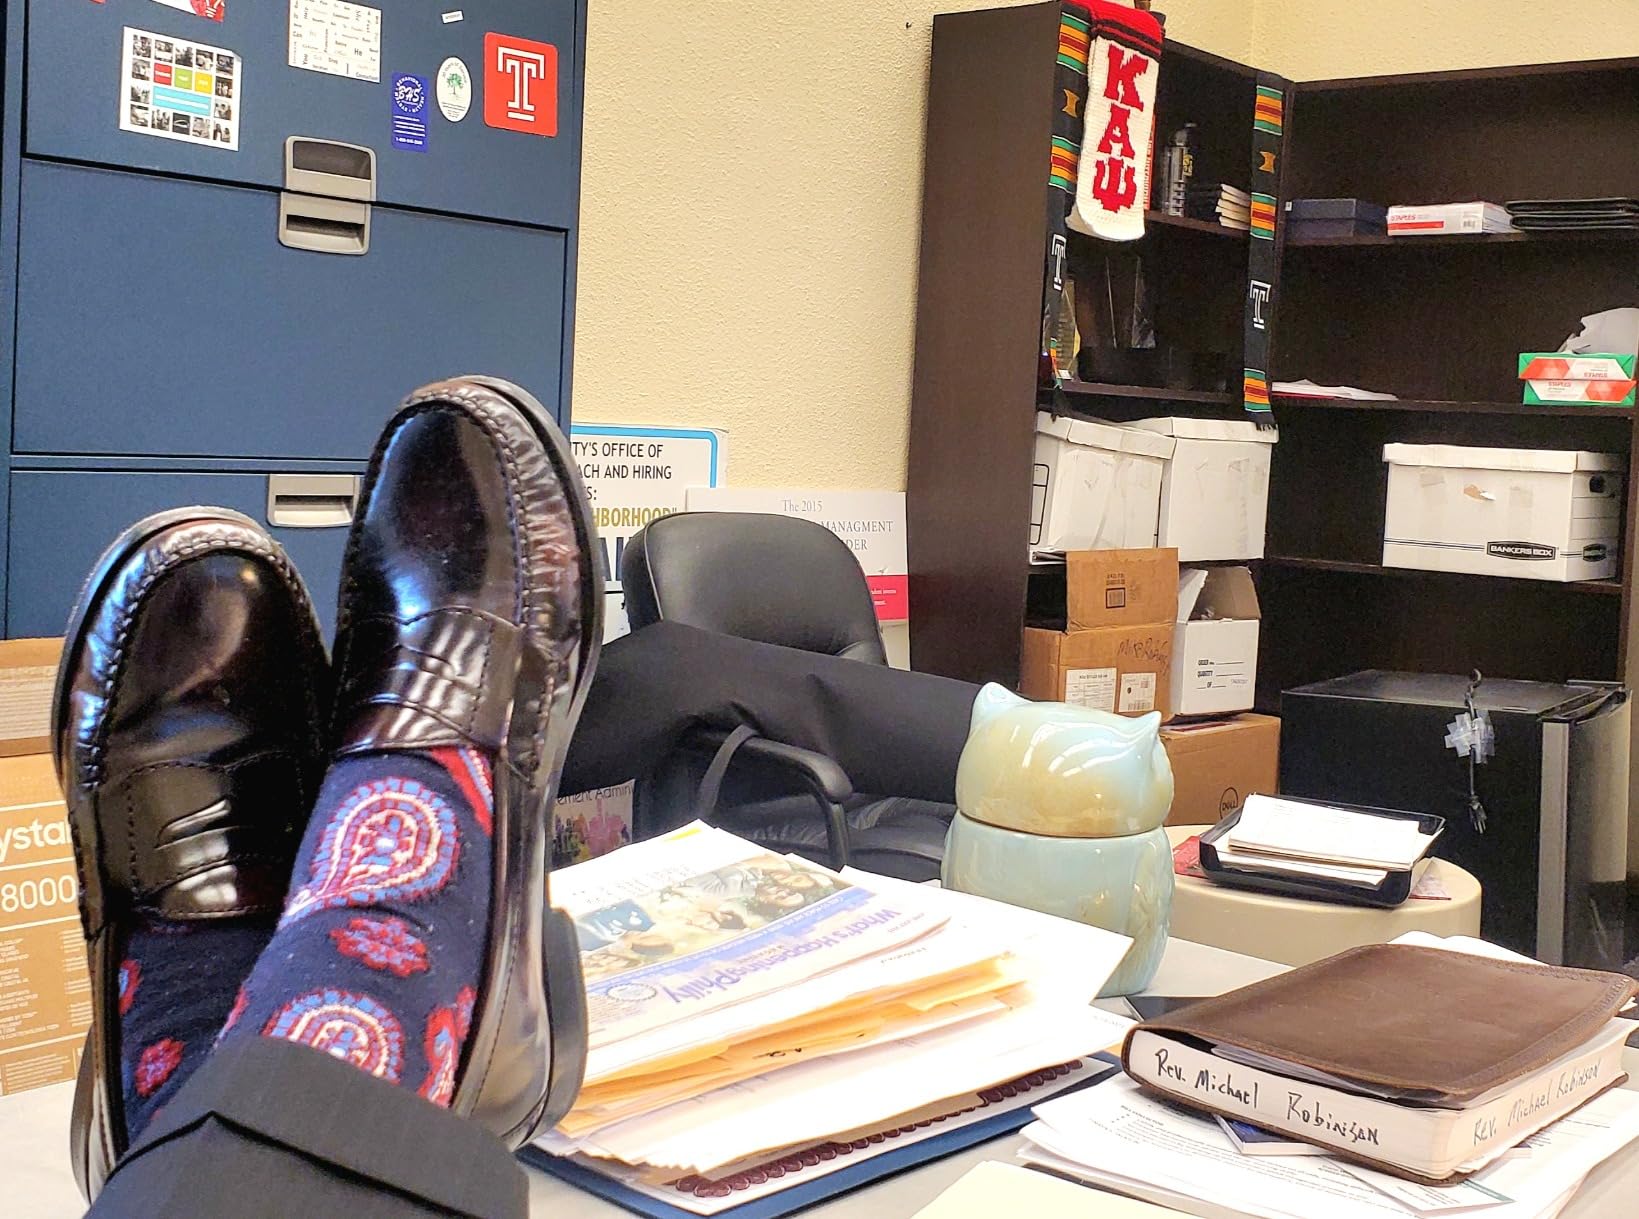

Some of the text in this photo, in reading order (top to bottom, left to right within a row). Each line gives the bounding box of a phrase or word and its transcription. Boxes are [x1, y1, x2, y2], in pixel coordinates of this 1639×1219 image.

[602, 443, 645, 457] OFFICE
[648, 444, 664, 458] OF
[604, 465, 629, 479] AND
[633, 465, 672, 479] HIRING
[784, 500, 823, 512] The 2015
[821, 521, 894, 533] MANAGMENT
[1491, 545, 1532, 555] BANKERS
[1, 875, 77, 912] 8000
[832, 909, 901, 938] What's
[1155, 1048, 1186, 1082] Rev.
[1194, 1069, 1259, 1109] Michael
